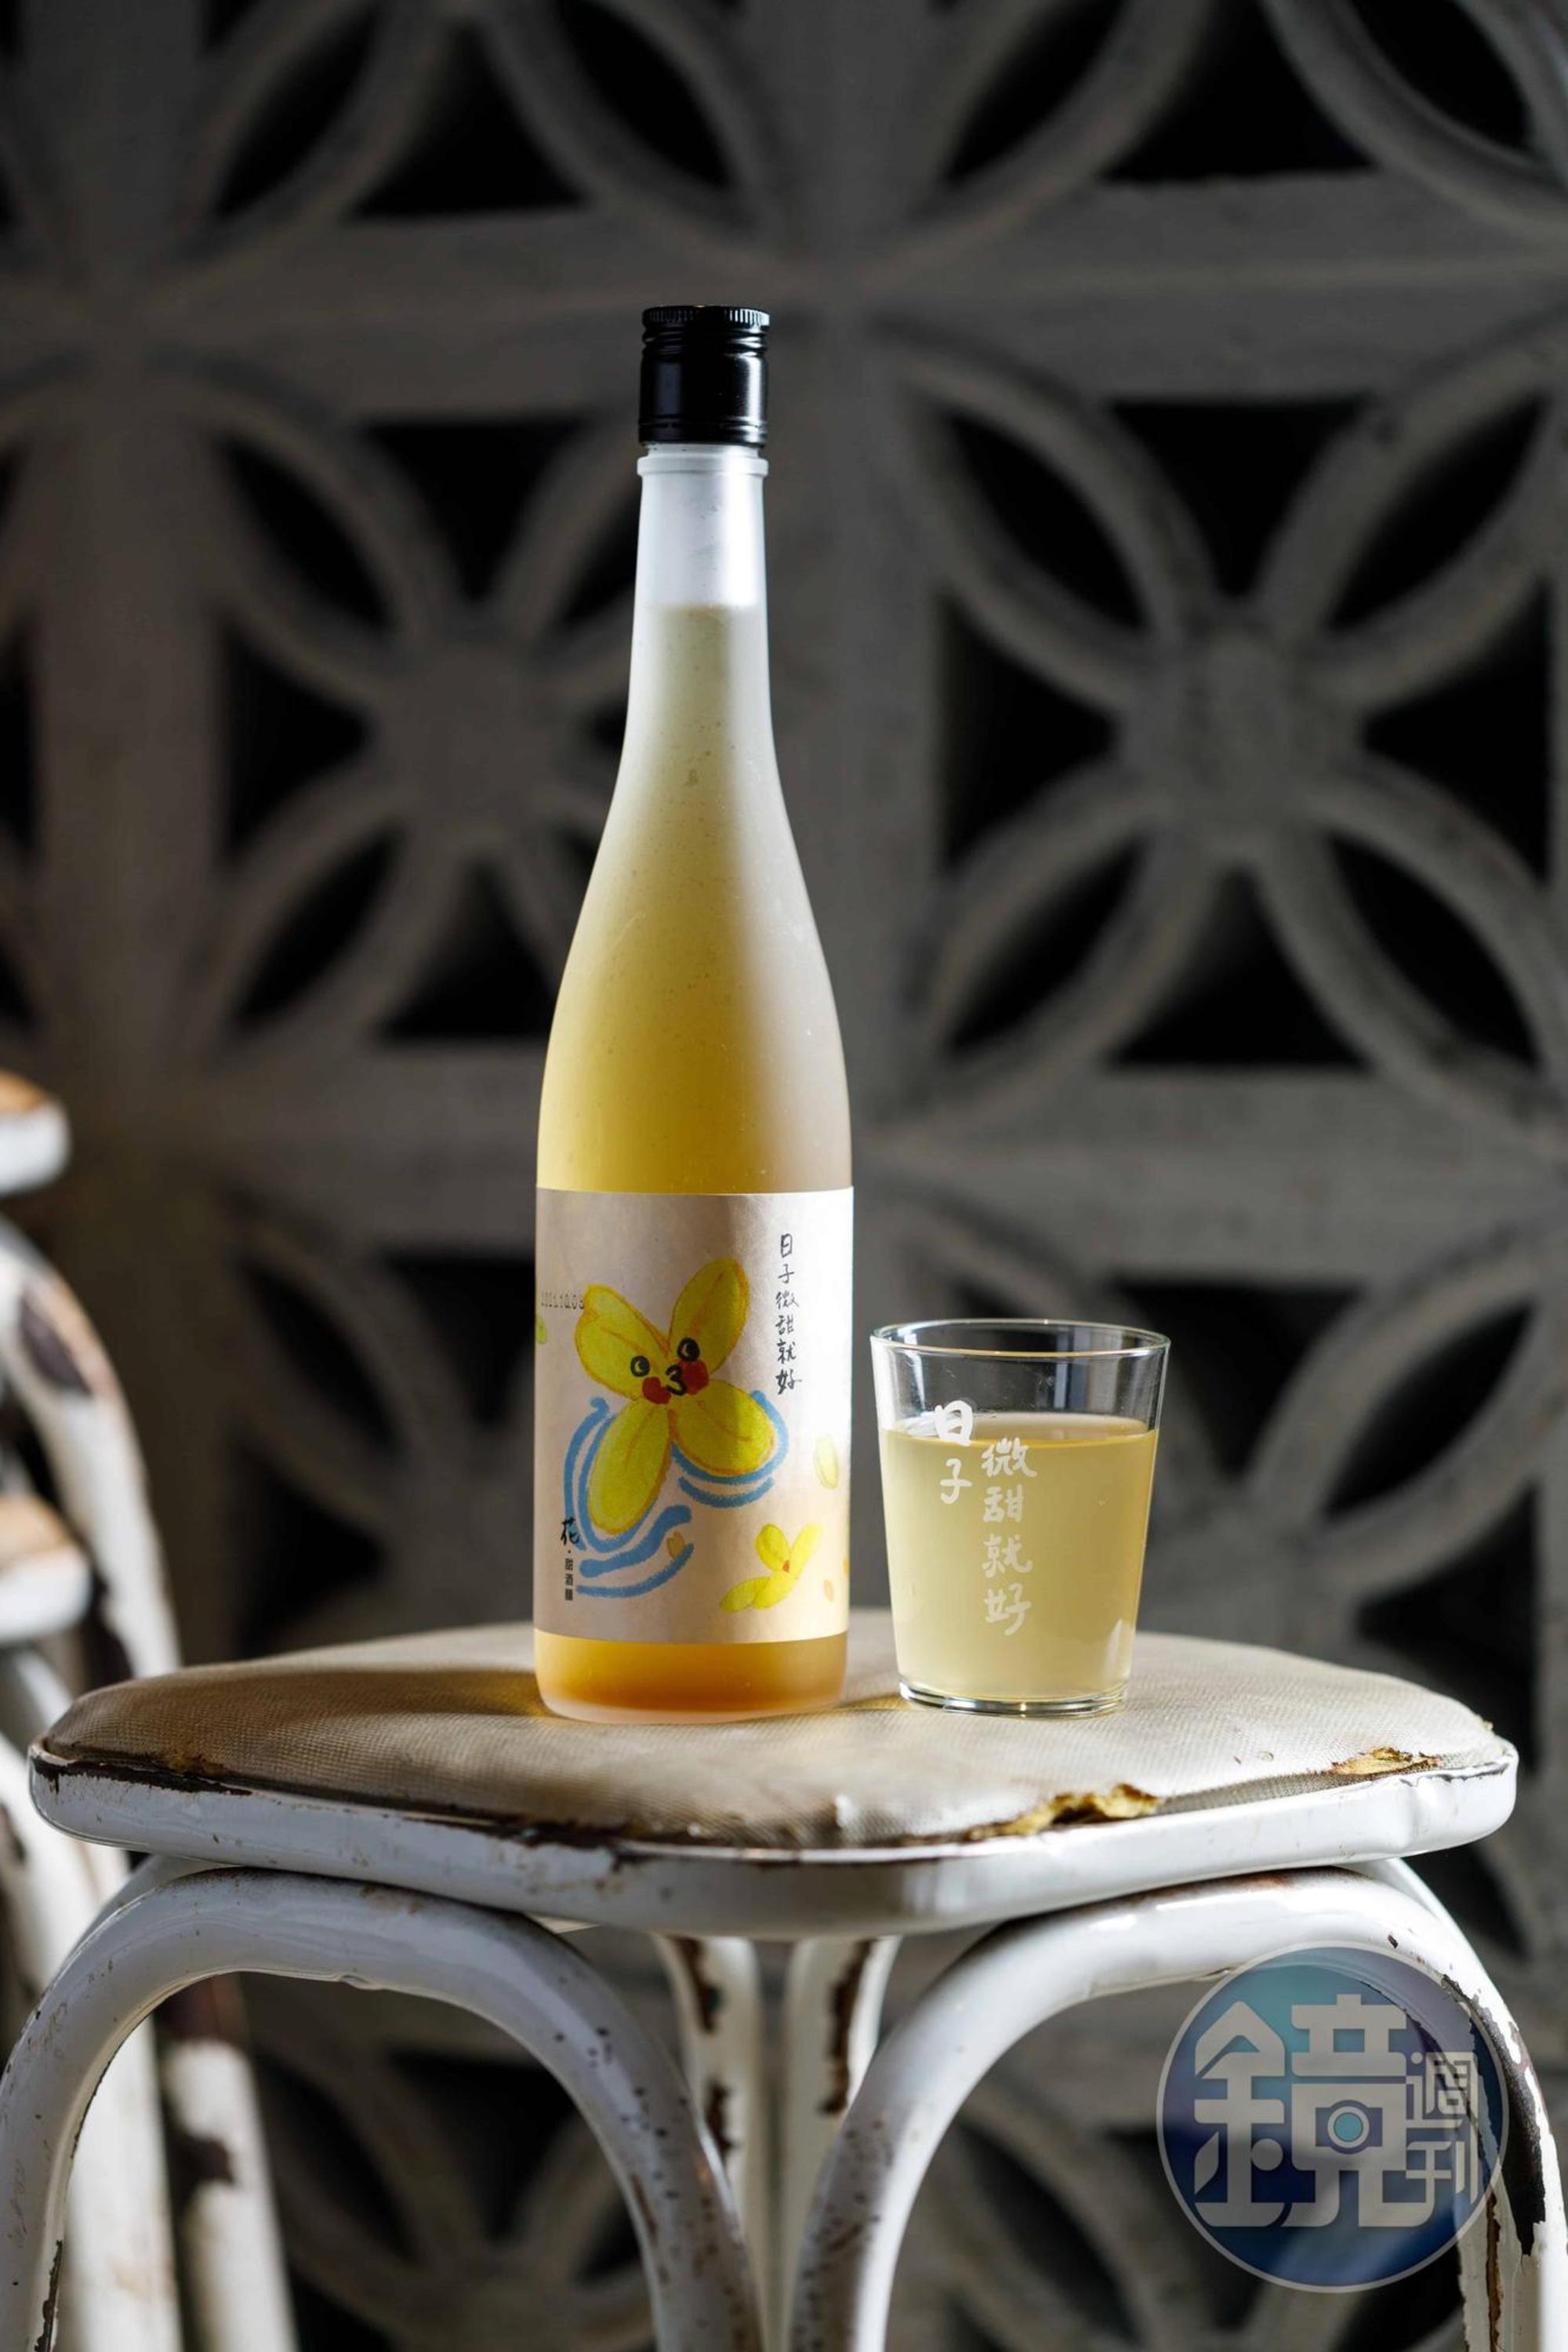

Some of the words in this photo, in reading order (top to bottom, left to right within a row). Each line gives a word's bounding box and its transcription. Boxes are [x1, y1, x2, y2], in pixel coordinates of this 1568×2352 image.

[775, 1233, 803, 1396] 日子微甜就好
[933, 1399, 974, 1504] 日子
[980, 1436, 1038, 1636] 微甜就好
